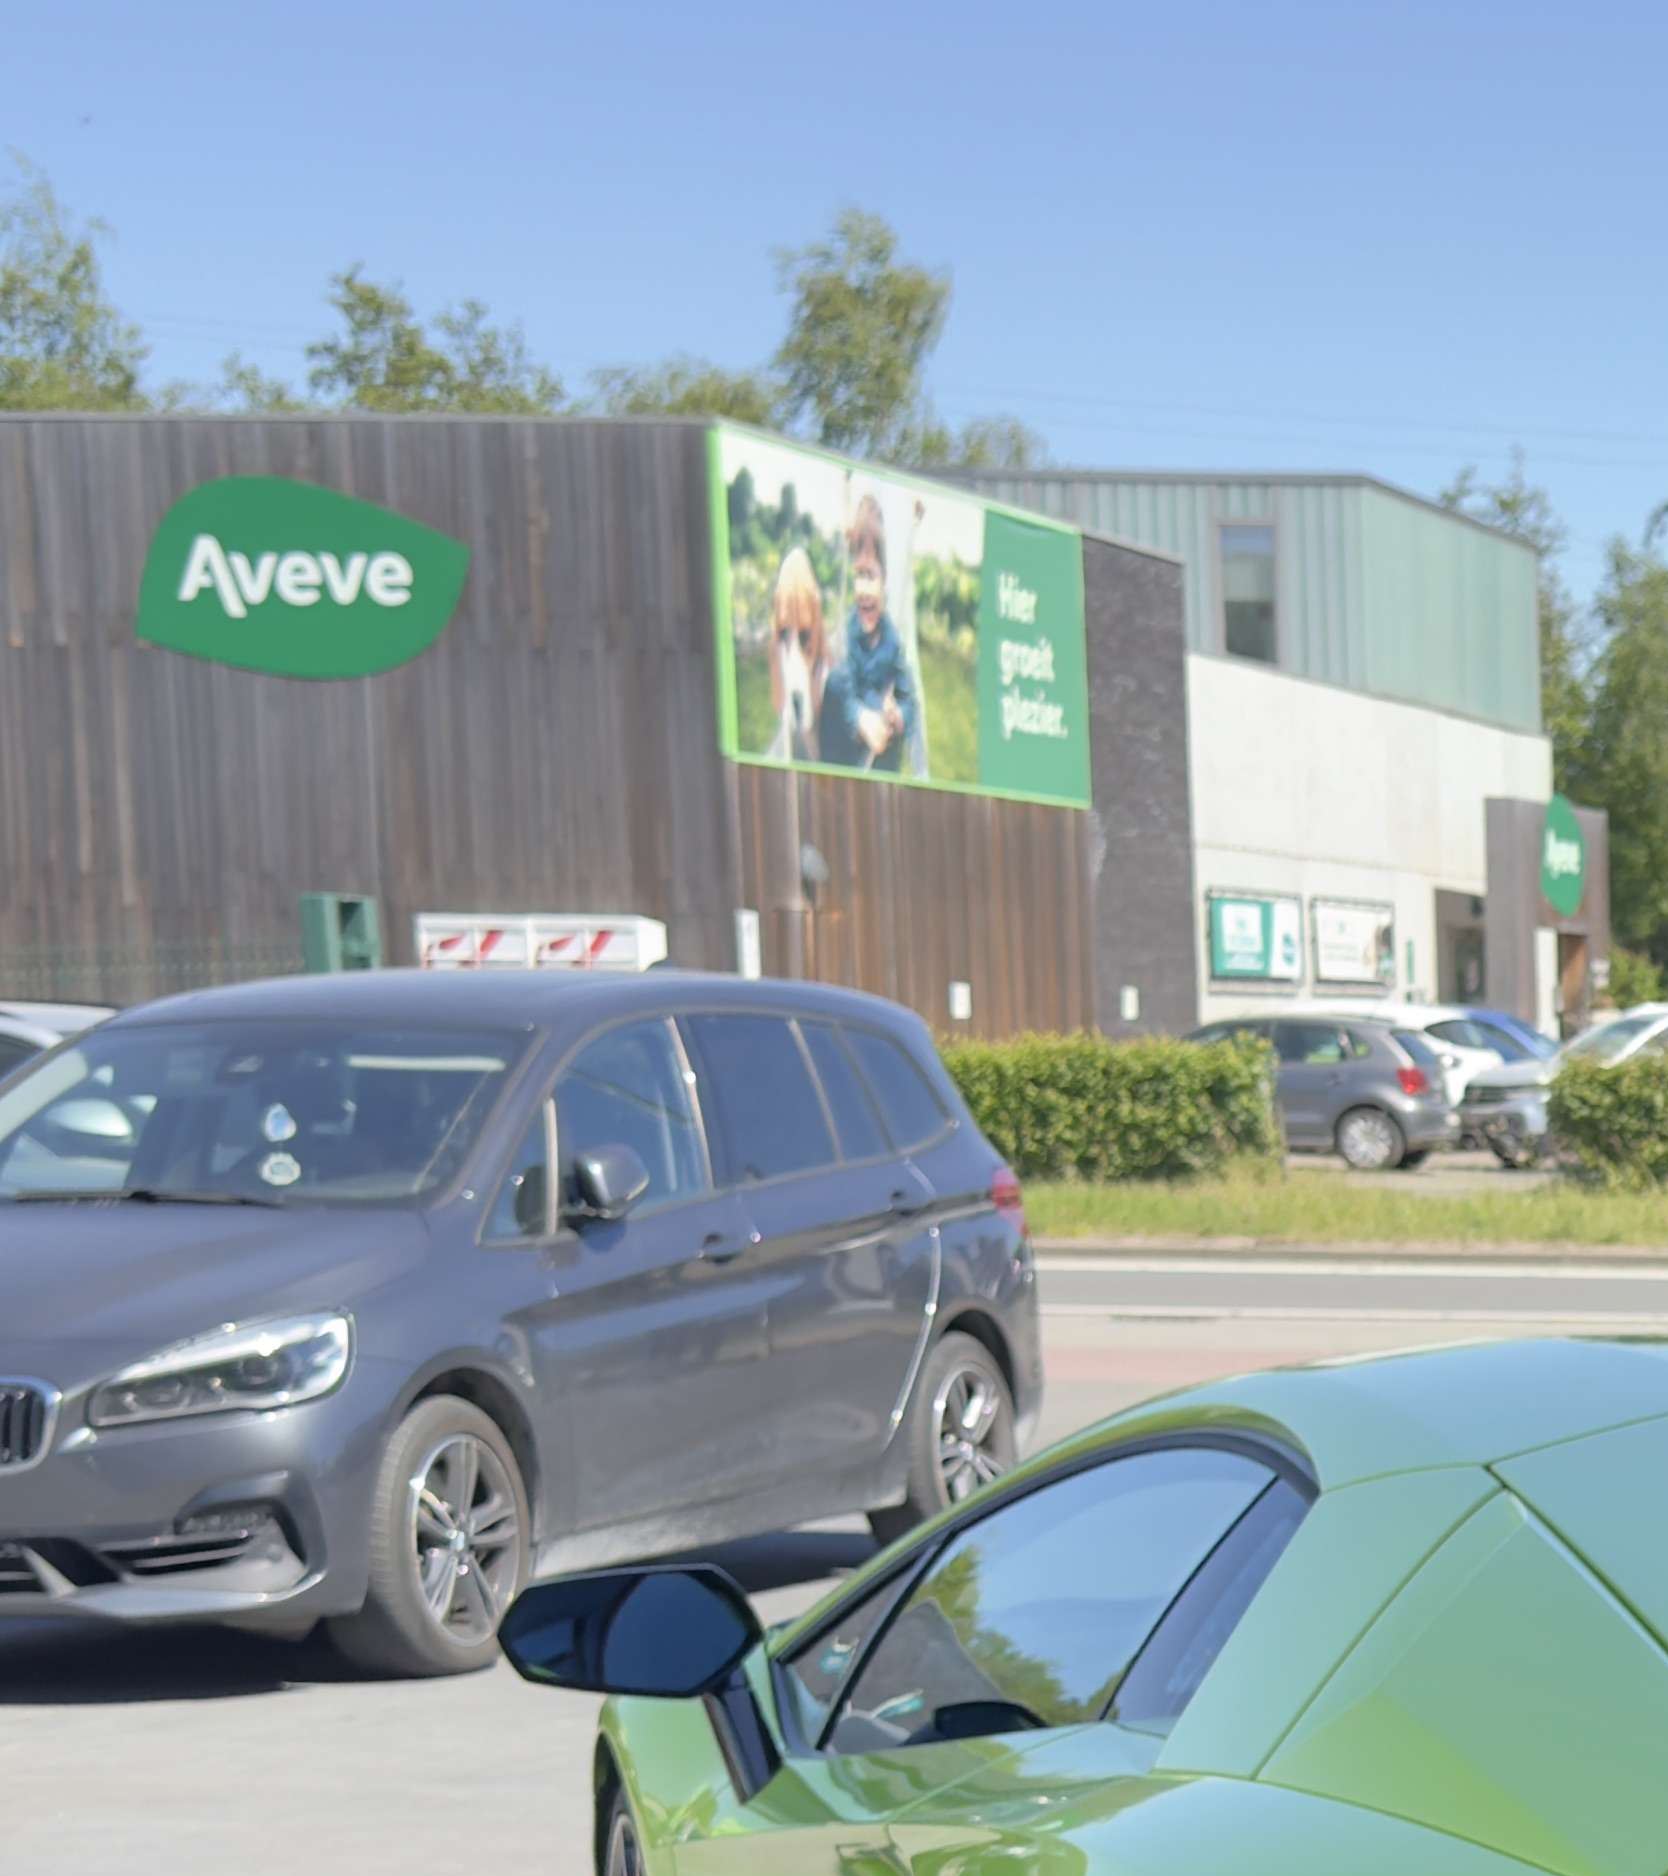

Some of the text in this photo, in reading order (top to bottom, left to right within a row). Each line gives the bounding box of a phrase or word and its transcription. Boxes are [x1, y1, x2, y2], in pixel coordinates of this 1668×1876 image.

[177, 533, 414, 618] Aveve
[998, 573, 1038, 624] Hier
[1000, 635, 1055, 686] groeit
